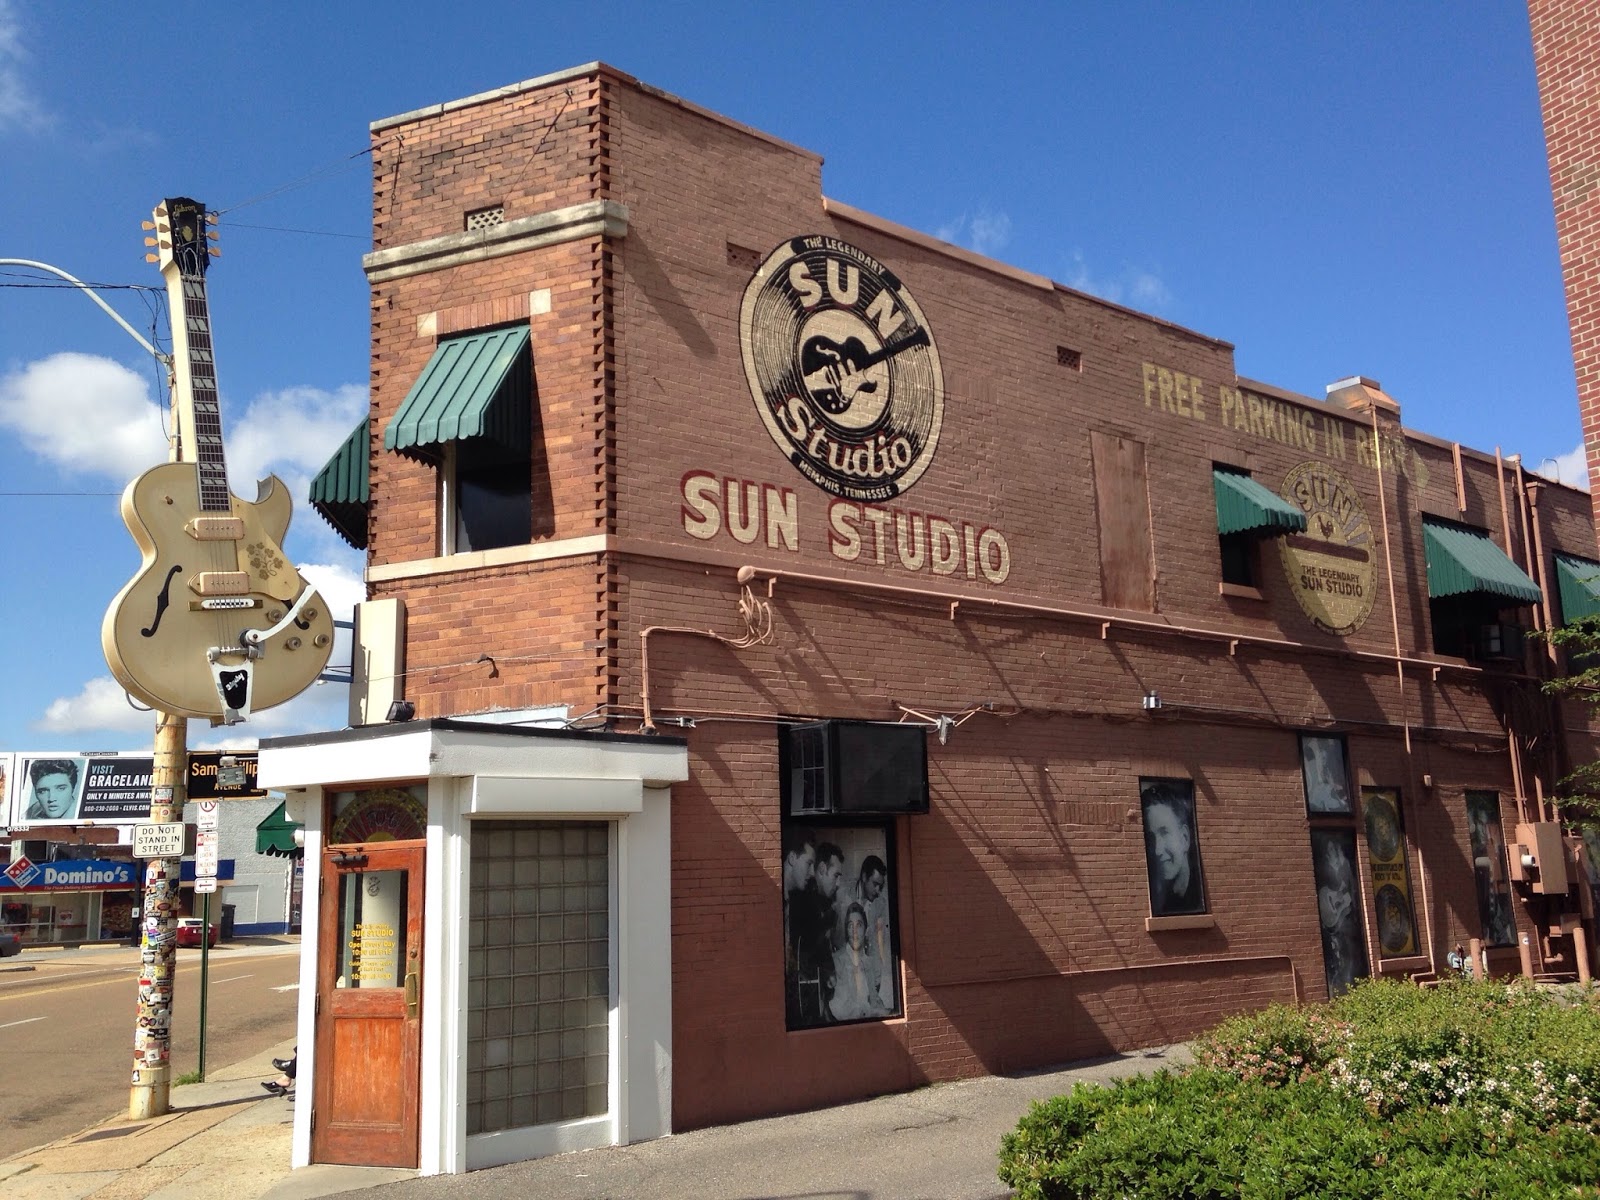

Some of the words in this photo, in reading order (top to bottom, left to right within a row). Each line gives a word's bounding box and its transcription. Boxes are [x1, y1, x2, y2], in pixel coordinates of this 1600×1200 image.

[803, 236, 823, 249] THE
[825, 237, 886, 275] LEGENDARY
[789, 258, 908, 340] SUN
[1142, 362, 1206, 421] FREE
[1220, 385, 1317, 453] PARKING
[1324, 417, 1346, 461] IN
[776, 394, 911, 478] Studio
[799, 460, 843, 495] MEMPHIS,
[843, 485, 893, 500] TENNESSEE
[1294, 475, 1352, 526] SUN
[680, 470, 799, 551] SUN
[828, 499, 1011, 584] STUDIO
[1301, 565, 1316, 576] THE
[1319, 568, 1360, 583] LEGENDARY
[1300, 575, 1323, 592] SUN
[1325, 579, 1363, 597] STUDIO
[91, 765, 114, 775] VISIT
[192, 763, 217, 776] Sam
[86, 792, 102, 800] ONLY
[108, 792, 134, 800] MINUTES
[138, 836, 167, 844] STAND
[158, 826, 176, 834] NOT
[142, 845, 175, 853] STREET
[44, 866, 129, 884] Domino's
